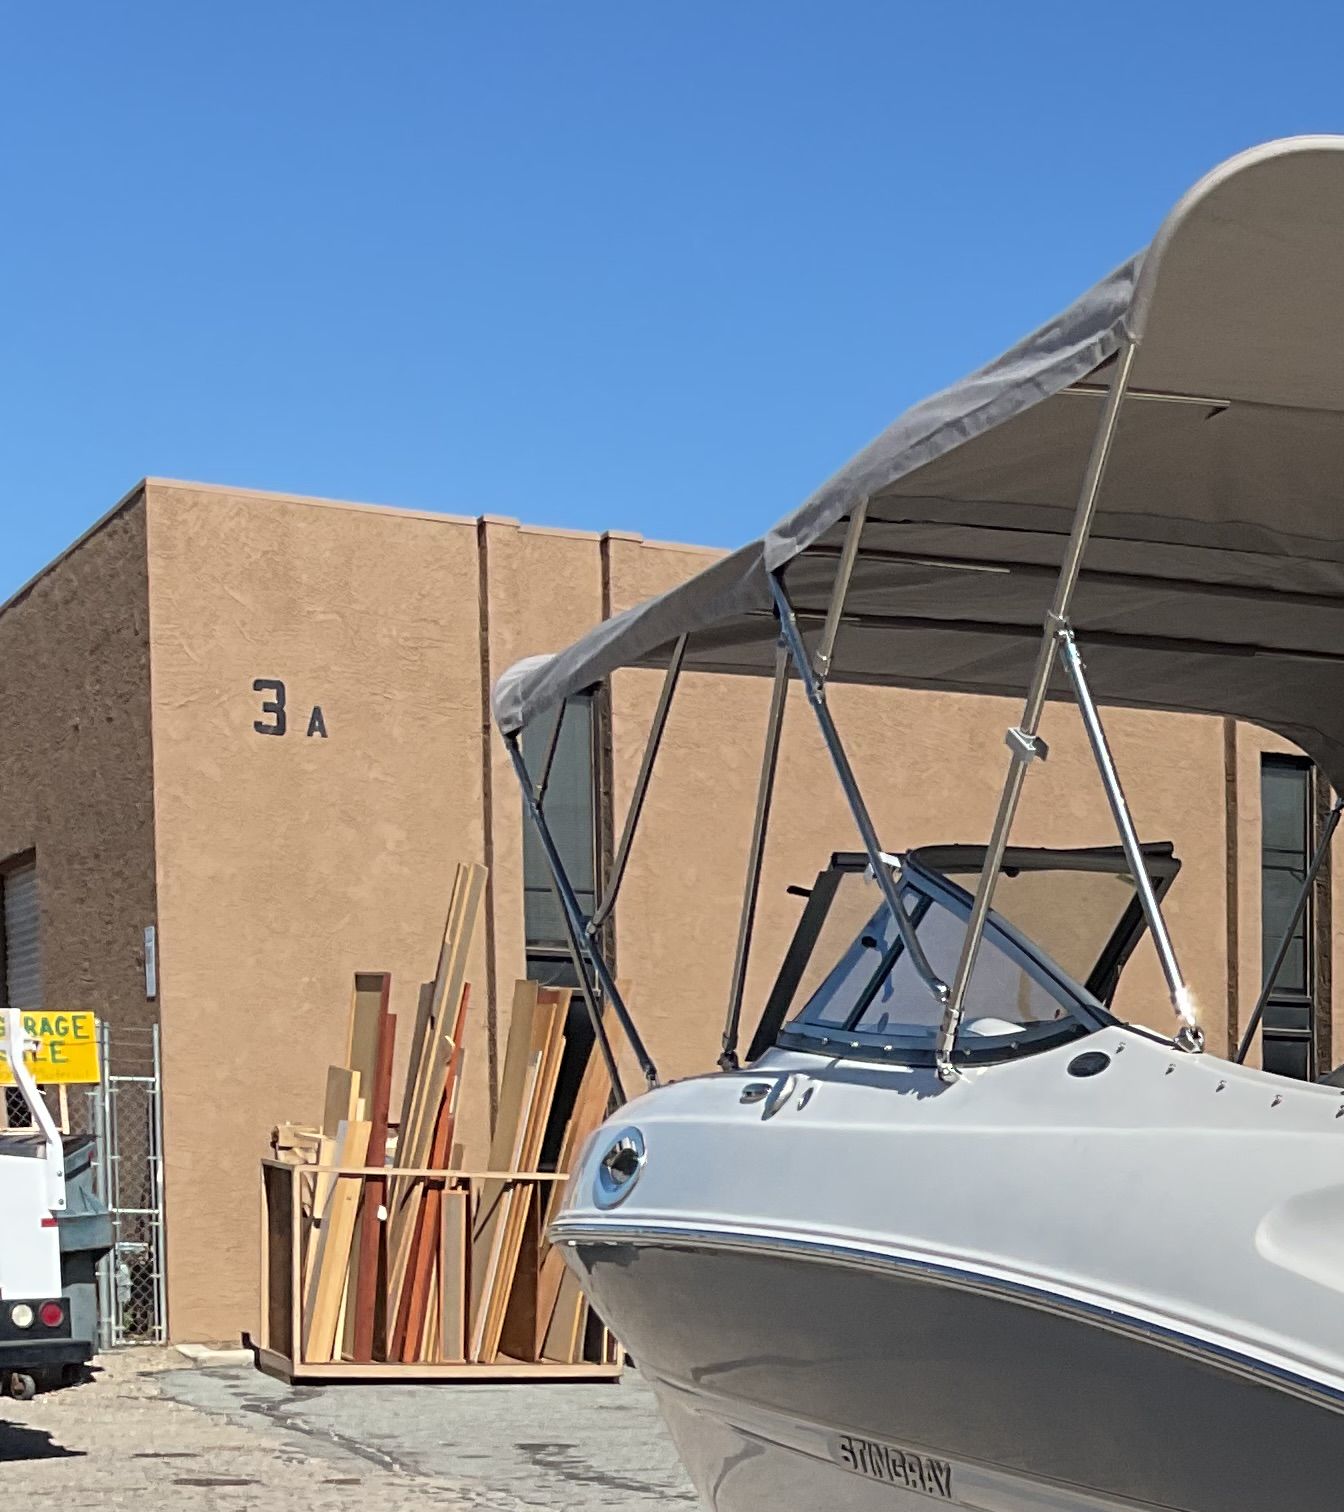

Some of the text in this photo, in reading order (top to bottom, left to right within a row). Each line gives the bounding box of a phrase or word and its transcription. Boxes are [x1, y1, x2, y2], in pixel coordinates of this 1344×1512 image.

[252, 678, 329, 738] 3 A
[839, 1434, 952, 1499] STINGRAY
